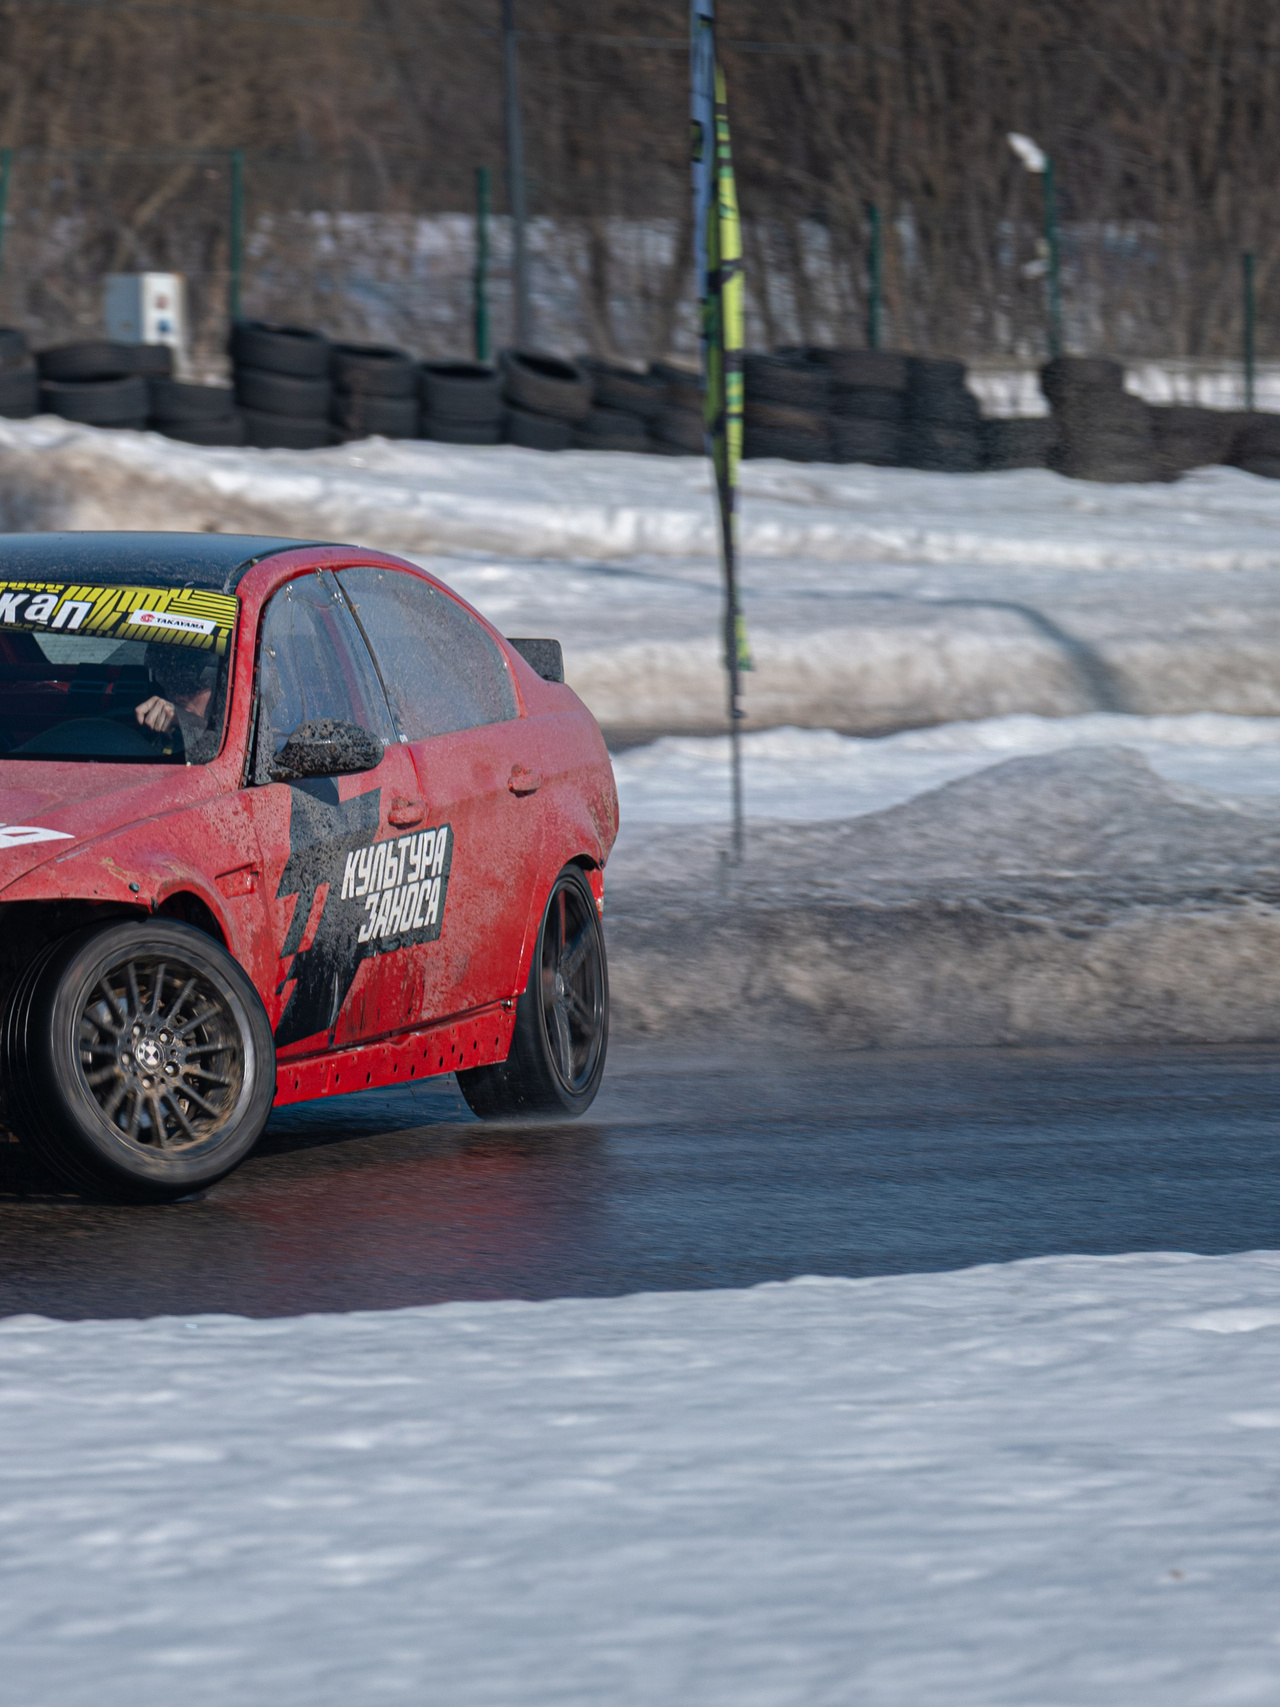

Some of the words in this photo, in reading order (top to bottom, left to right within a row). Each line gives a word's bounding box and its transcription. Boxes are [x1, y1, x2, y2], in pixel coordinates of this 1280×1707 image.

[156, 617, 205, 631] TAKAYAMA
[340, 826, 448, 901] КУЛЬТУРА
[357, 876, 441, 944] ЗАНОСА
